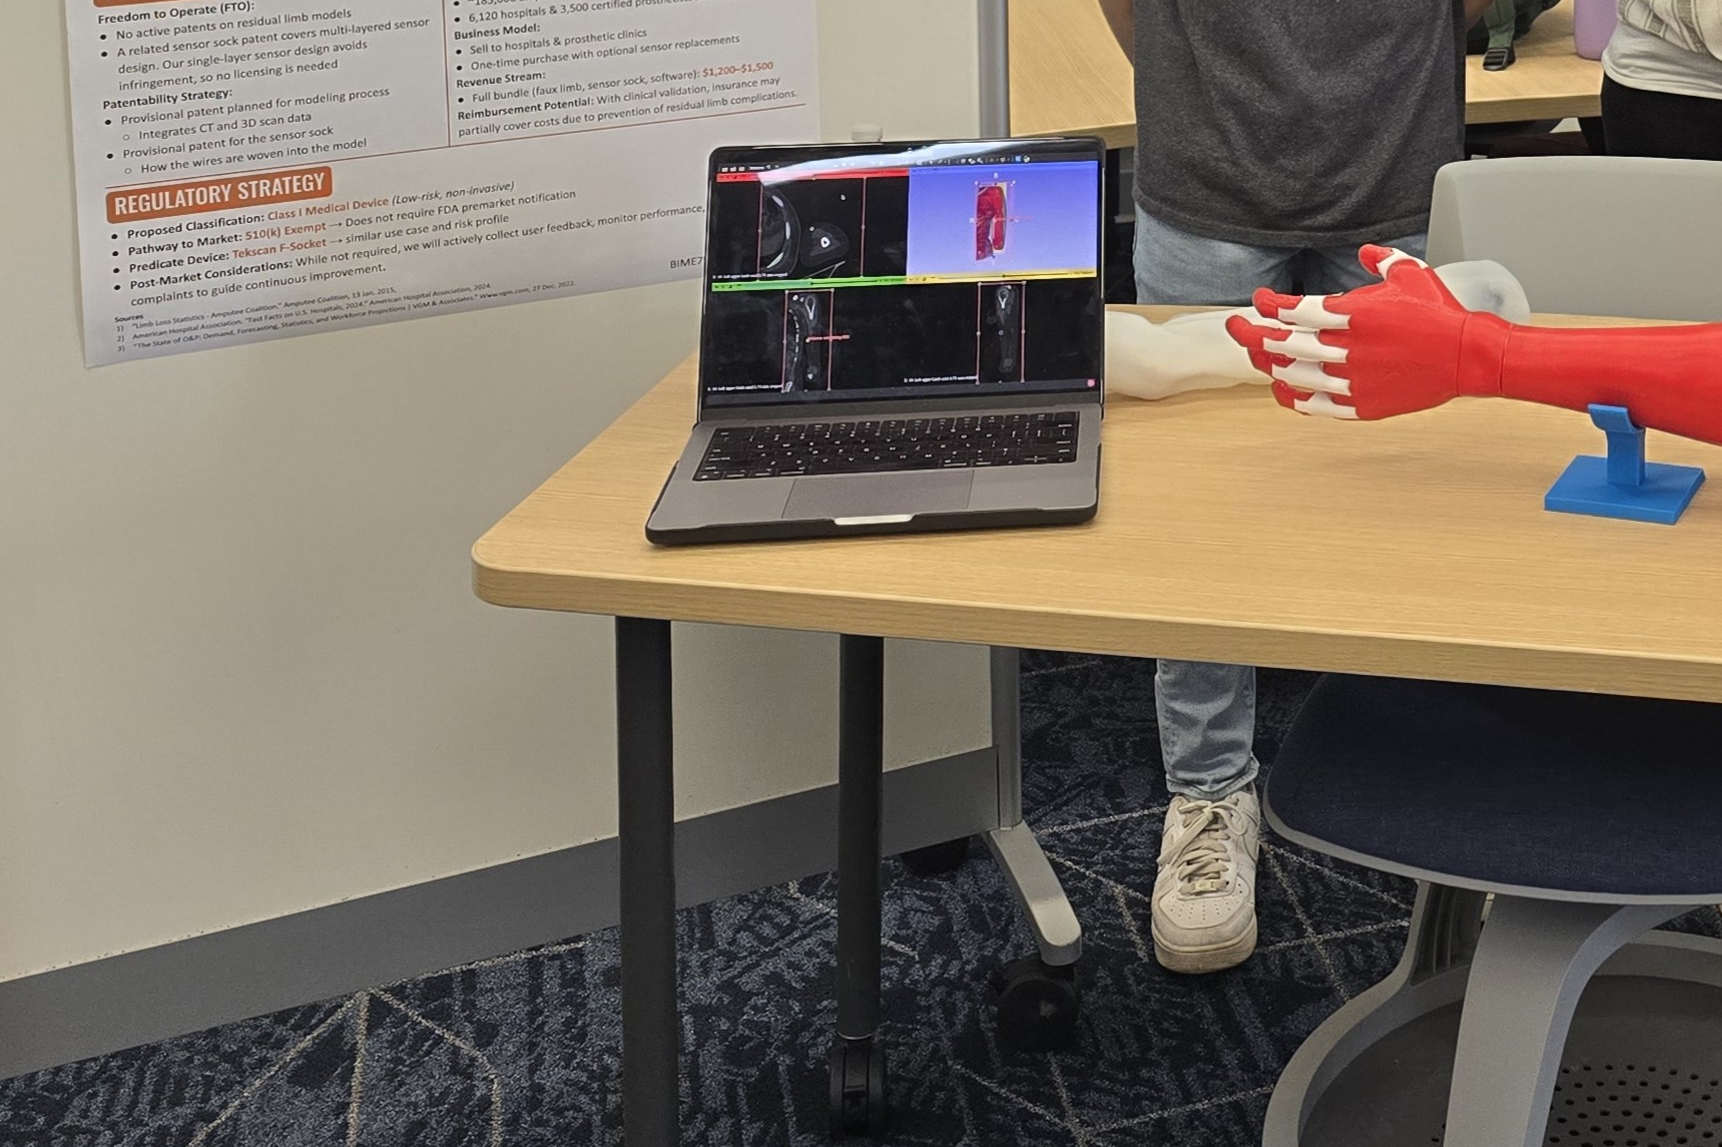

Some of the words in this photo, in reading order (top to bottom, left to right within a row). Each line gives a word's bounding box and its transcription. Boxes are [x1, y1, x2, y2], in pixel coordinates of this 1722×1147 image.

[98, 12, 151, 24] Freedom
[154, 10, 167, 19] to
[169, 6, 217, 18] Operate
[220, 0, 255, 14] (FTO):
[116, 30, 134, 40] No
[136, 27, 171, 38] active
[173, 23, 217, 36] patents
[219, 21, 234, 30] on
[237, 14, 282, 28] residual
[284, 12, 309, 23] limb
[311, 8, 352, 20] models
[454, 28, 500, 40] Business
[502, 23, 540, 35] Model:
[114, 183, 232, 215] REGULATORY
[237, 172, 325, 200] STRATEGY
[127, 222, 183, 239] Proposed
[185, 214, 265, 231] Classification:
[267, 210, 296, 220] Class
[298, 208, 302, 216] I
[305, 202, 350, 215] Medical
[352, 198, 389, 209] Device
[392, 190, 442, 206] (Low-risk,
[446, 181, 514, 198] non-invasive)
[128, 242, 179, 256] Pathway
[181, 241, 194, 249] to
[197, 234, 242, 247] Market:
[245, 227, 281, 240] 510(k)
[284, 222, 326, 235] Exempt
[670, 256, 704, 269] BIME7
